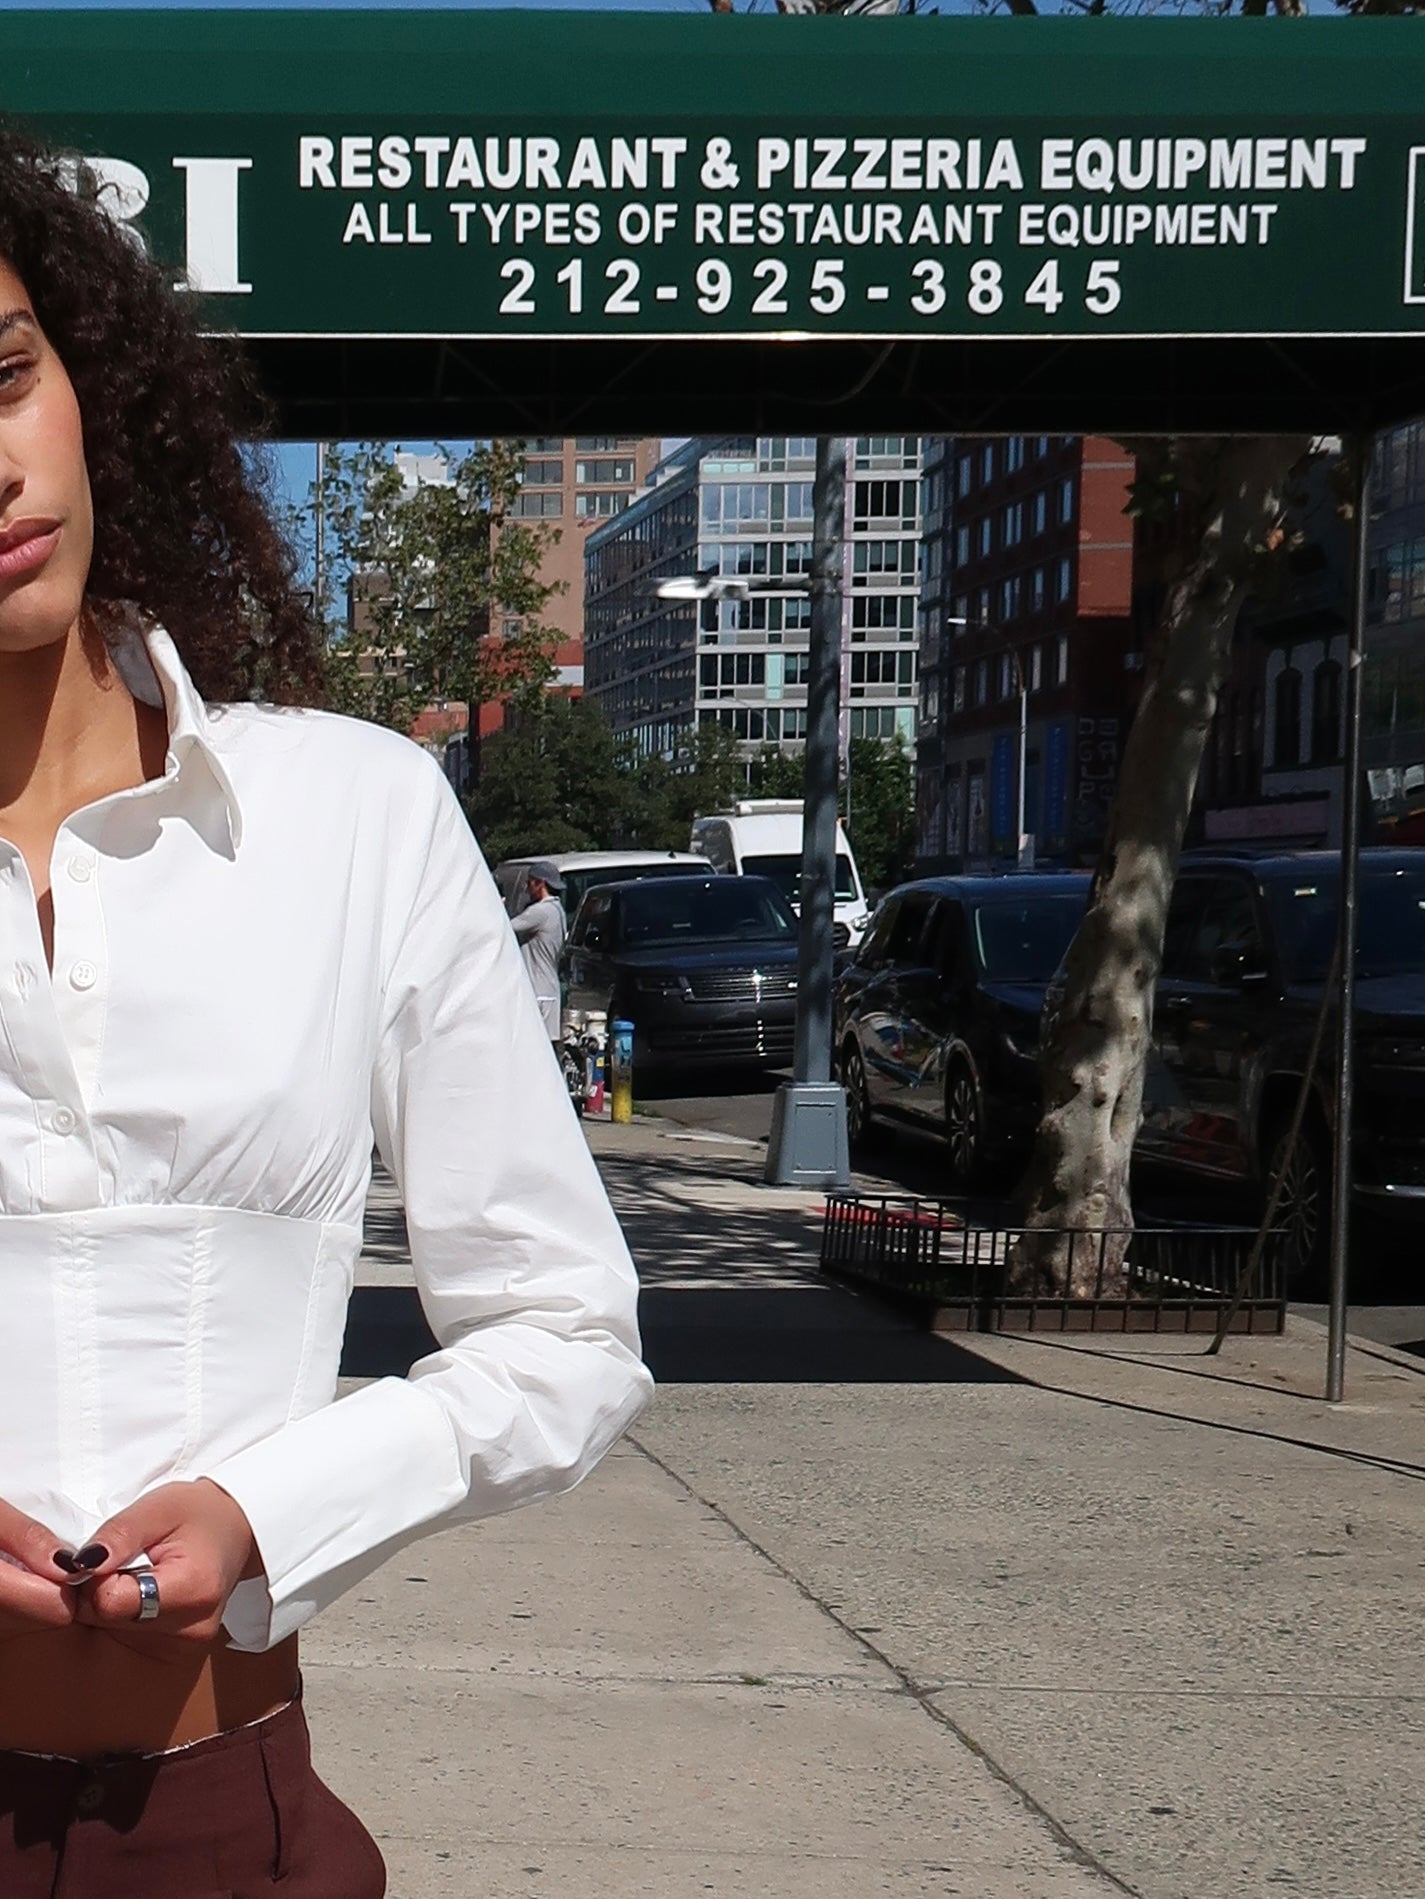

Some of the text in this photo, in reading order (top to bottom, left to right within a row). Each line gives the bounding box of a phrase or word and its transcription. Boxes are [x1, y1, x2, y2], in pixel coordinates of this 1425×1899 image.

[299, 136, 1367, 194] RESTAURANT & PIZZERIA EQUIPMENT
[342, 202, 1278, 248] ALL TYPES OF RESTAURANT EQUIPMENT
[499, 258, 1121, 314] 212-925-3845
